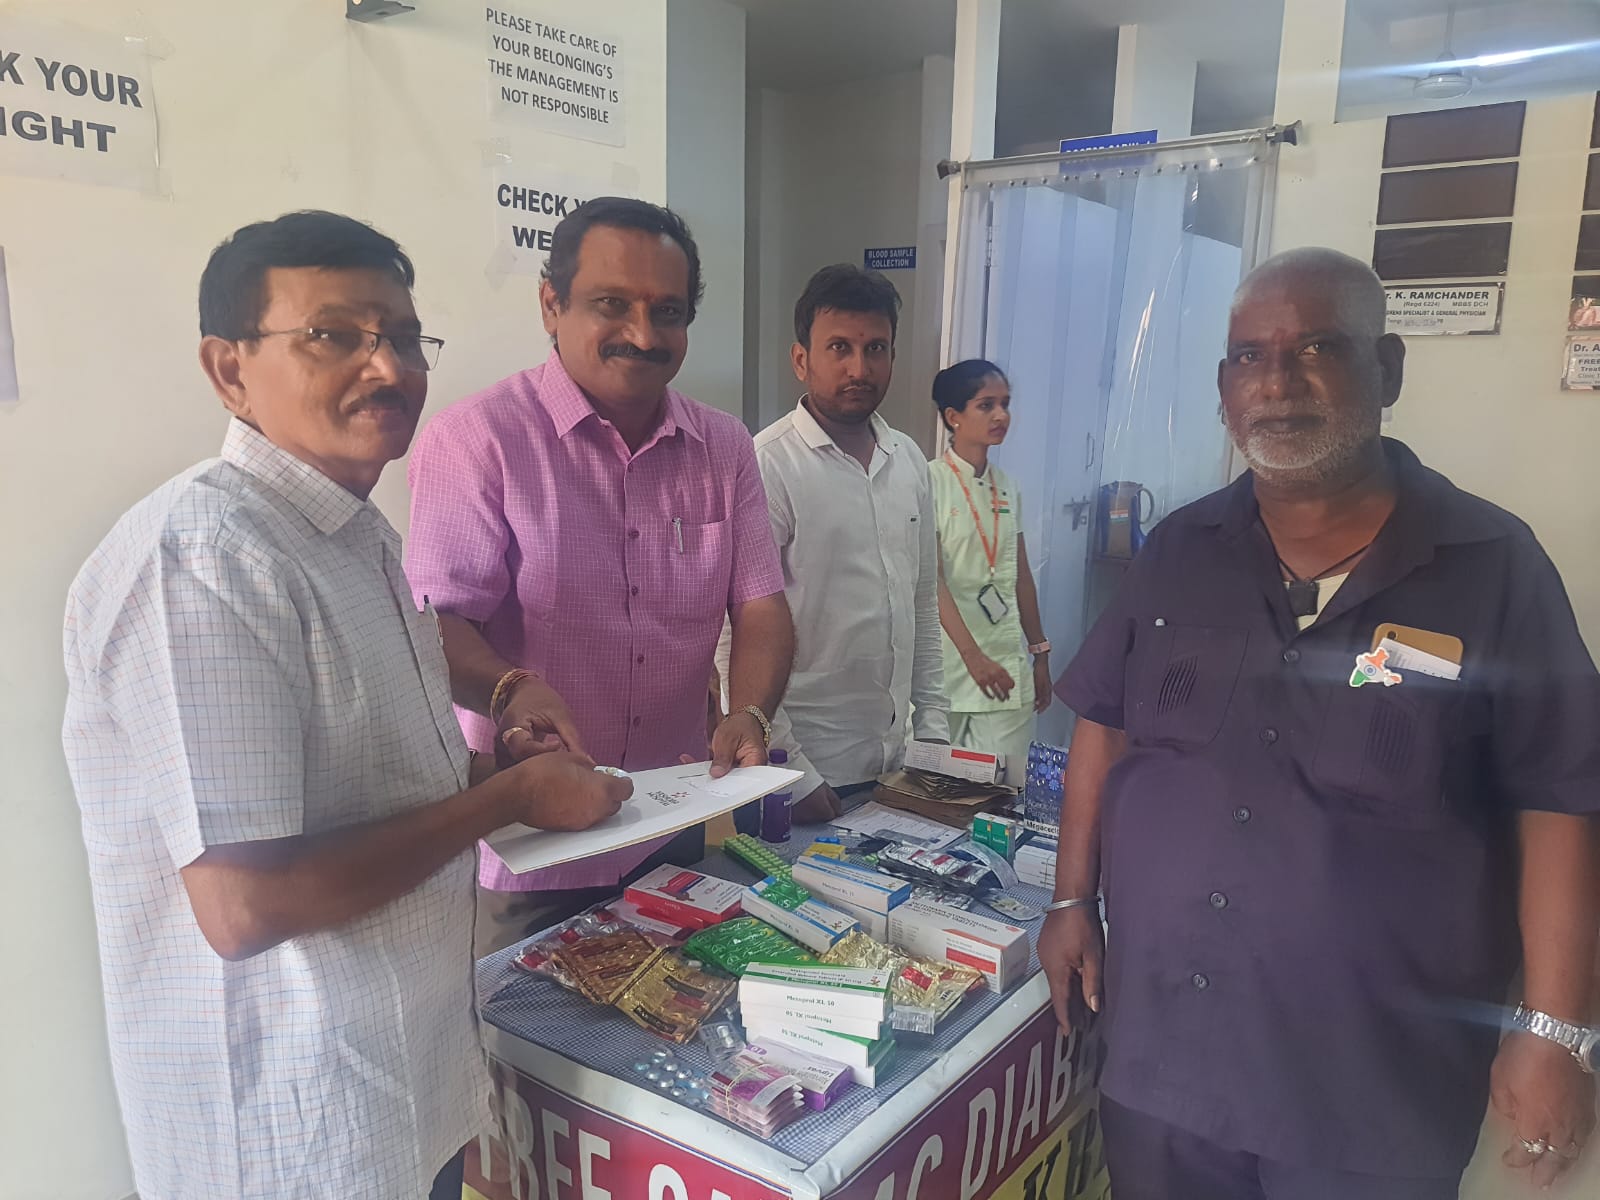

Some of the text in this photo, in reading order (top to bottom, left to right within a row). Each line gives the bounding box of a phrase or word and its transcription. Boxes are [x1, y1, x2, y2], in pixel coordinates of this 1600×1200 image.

[486, 7, 617, 58] PLEASE TAKE CARE OF
[493, 34, 613, 80] YOUR BELONGING'S
[34, 56, 143, 108] YOUR
[488, 58, 619, 104] THE MANAGEMENT IS
[501, 86, 609, 124] NOT RESPONSIBLE
[497, 183, 568, 219] CHECK
[869, 249, 913, 258] BLOOD SAMPLE
[872, 259, 909, 268] COLLECTION
[1395, 291, 1406, 300] K.
[1410, 291, 1489, 300] RAMCHANDER
[1574, 344, 1588, 352] Dr.
